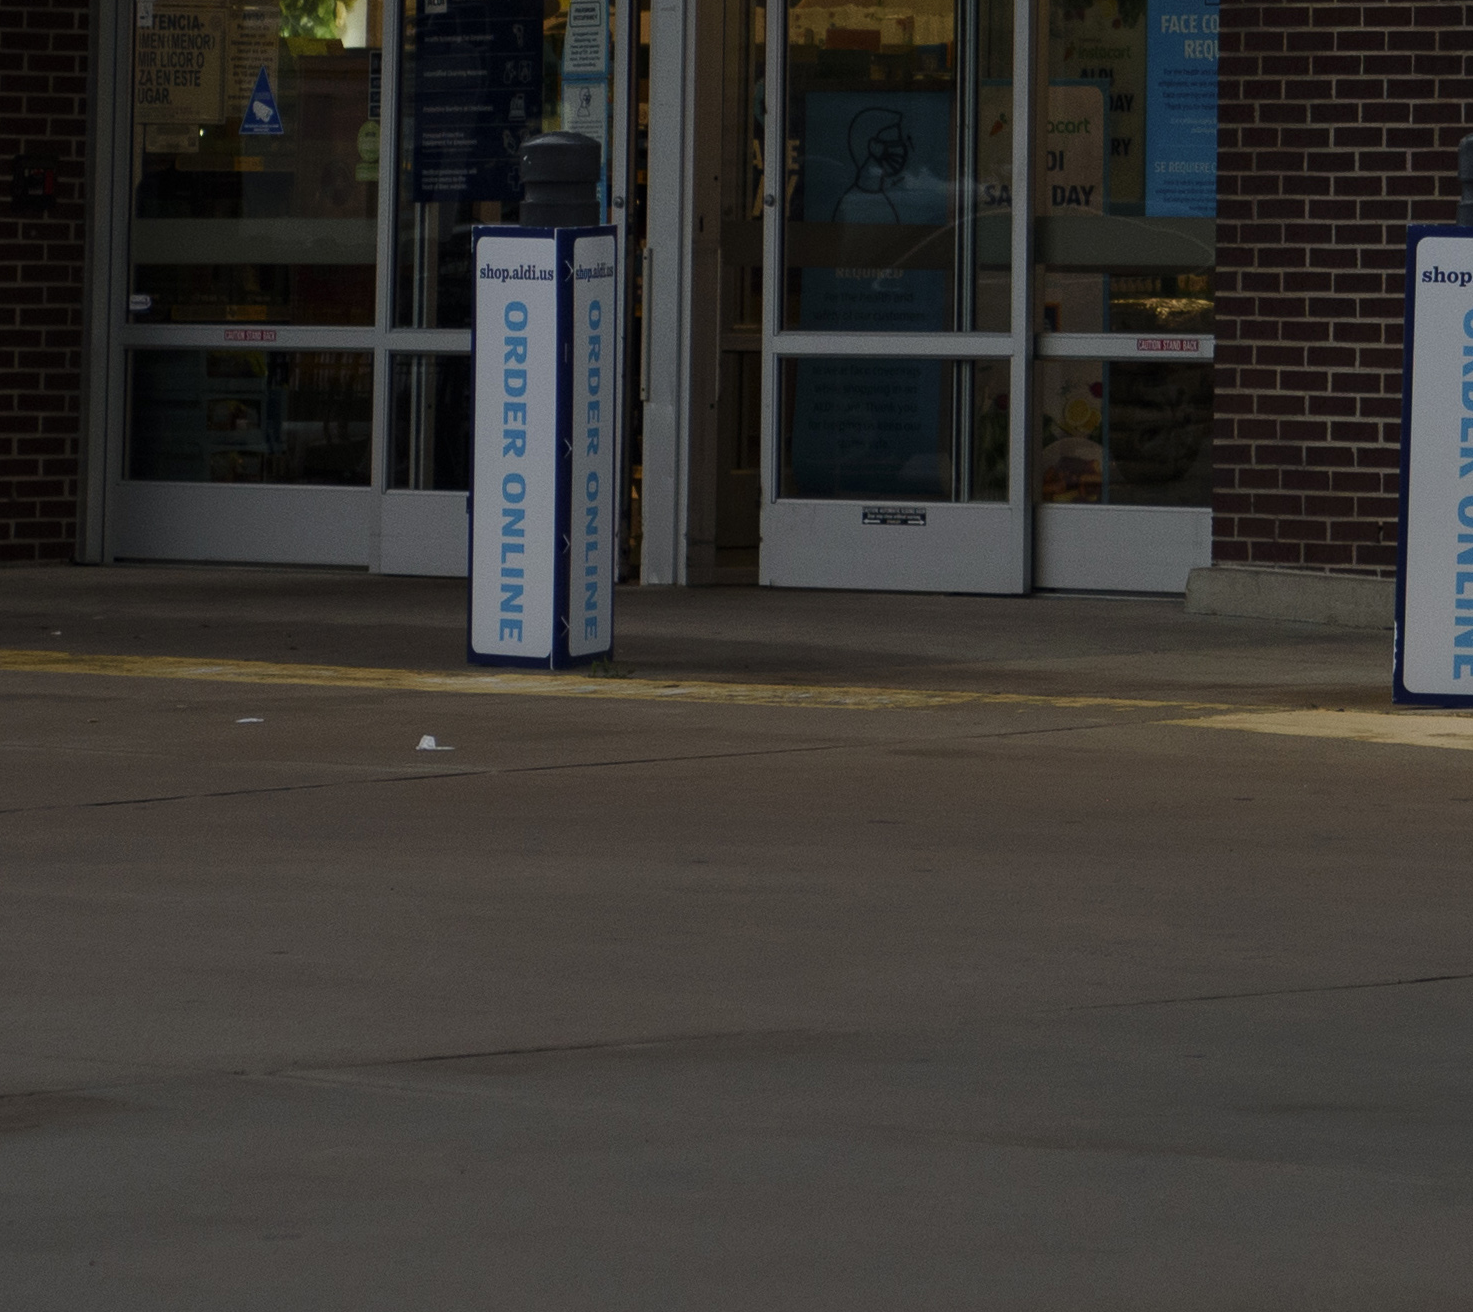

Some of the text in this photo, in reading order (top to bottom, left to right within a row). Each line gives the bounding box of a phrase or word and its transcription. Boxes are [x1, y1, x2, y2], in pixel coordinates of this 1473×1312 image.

[1161, 15, 1197, 33] FACE
[167, 33, 216, 51] (MENOR)
[160, 52, 193, 68] LICOR
[196, 52, 205, 68] O
[156, 70, 171, 86] EN
[174, 70, 201, 86] ESTE
[1155, 161, 1166, 173] SE
[1169, 161, 1211, 174] REQUIERE
[1052, 185, 1094, 206] DAY
[479, 264, 554, 283] shop.aldi.us
[575, 262, 614, 282] shop.aldi.us
[1138, 339, 1197, 351] CAUTION STAND BACK
[499, 300, 529, 644] ORDER ONLINE
[583, 299, 602, 641] ORDER ONLINE
